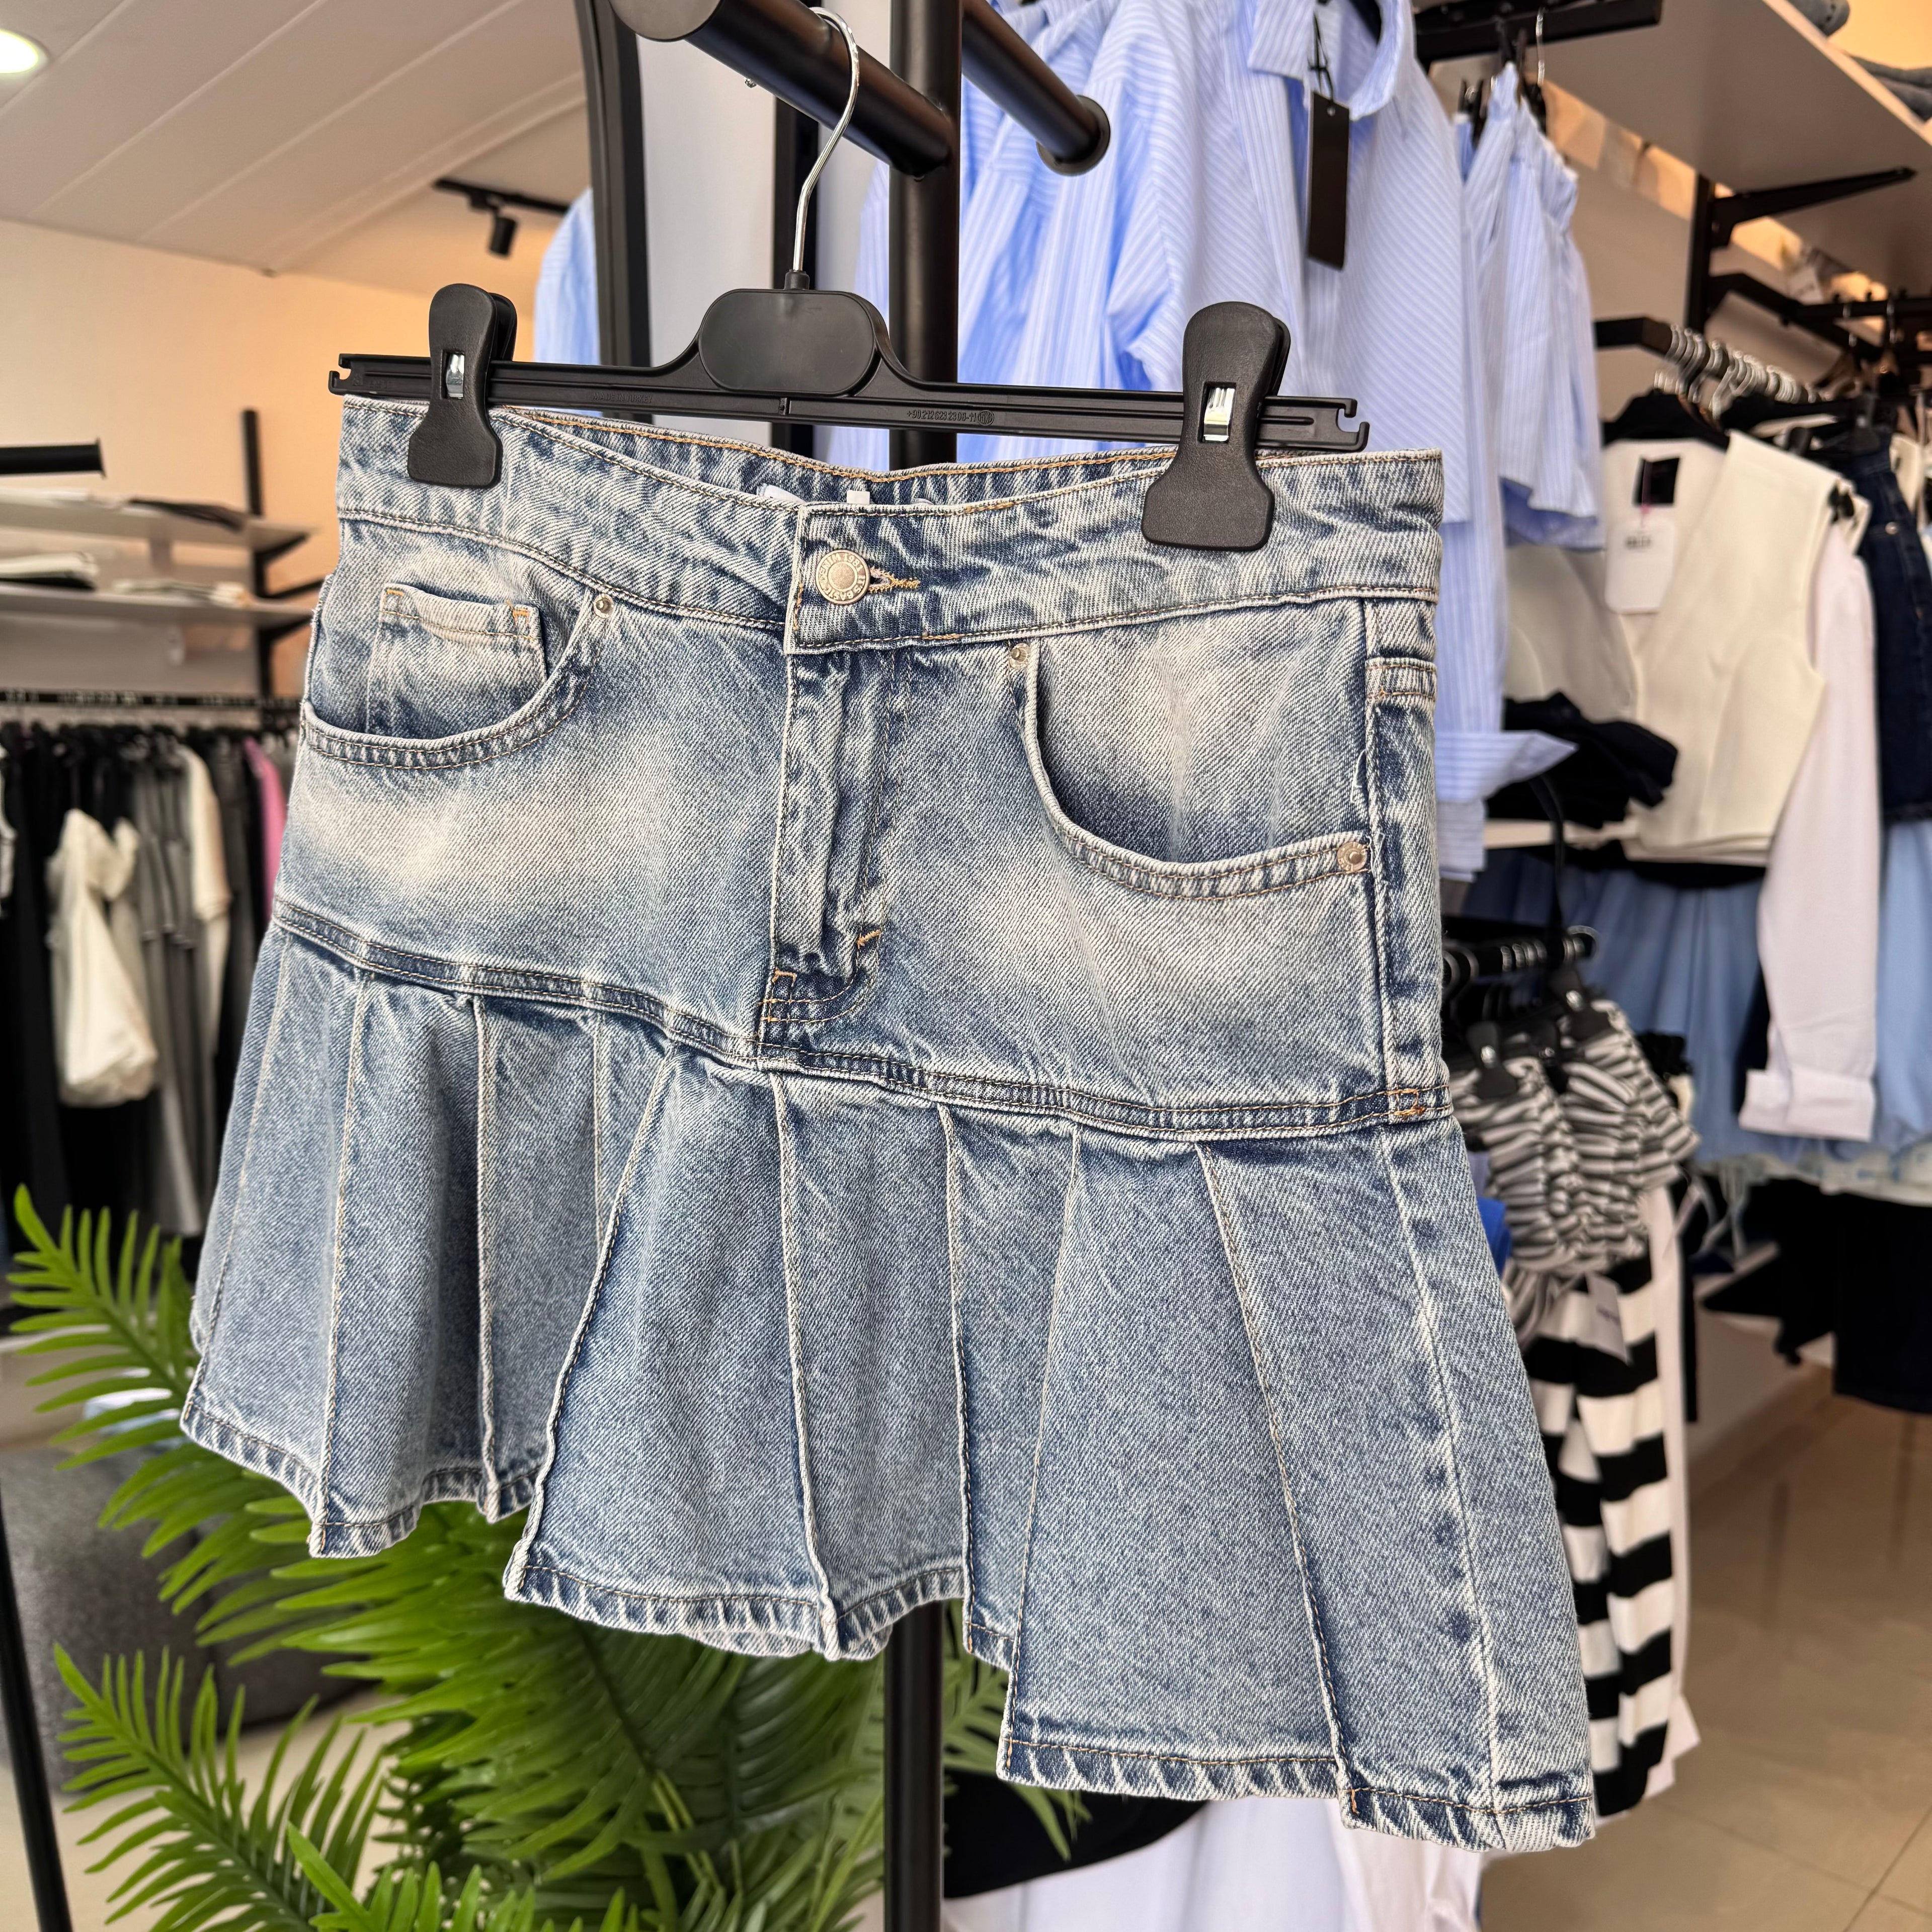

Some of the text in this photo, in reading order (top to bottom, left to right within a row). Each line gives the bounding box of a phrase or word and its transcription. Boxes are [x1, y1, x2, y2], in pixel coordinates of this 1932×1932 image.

[592, 392, 653, 404] MADE IN TURKEY
